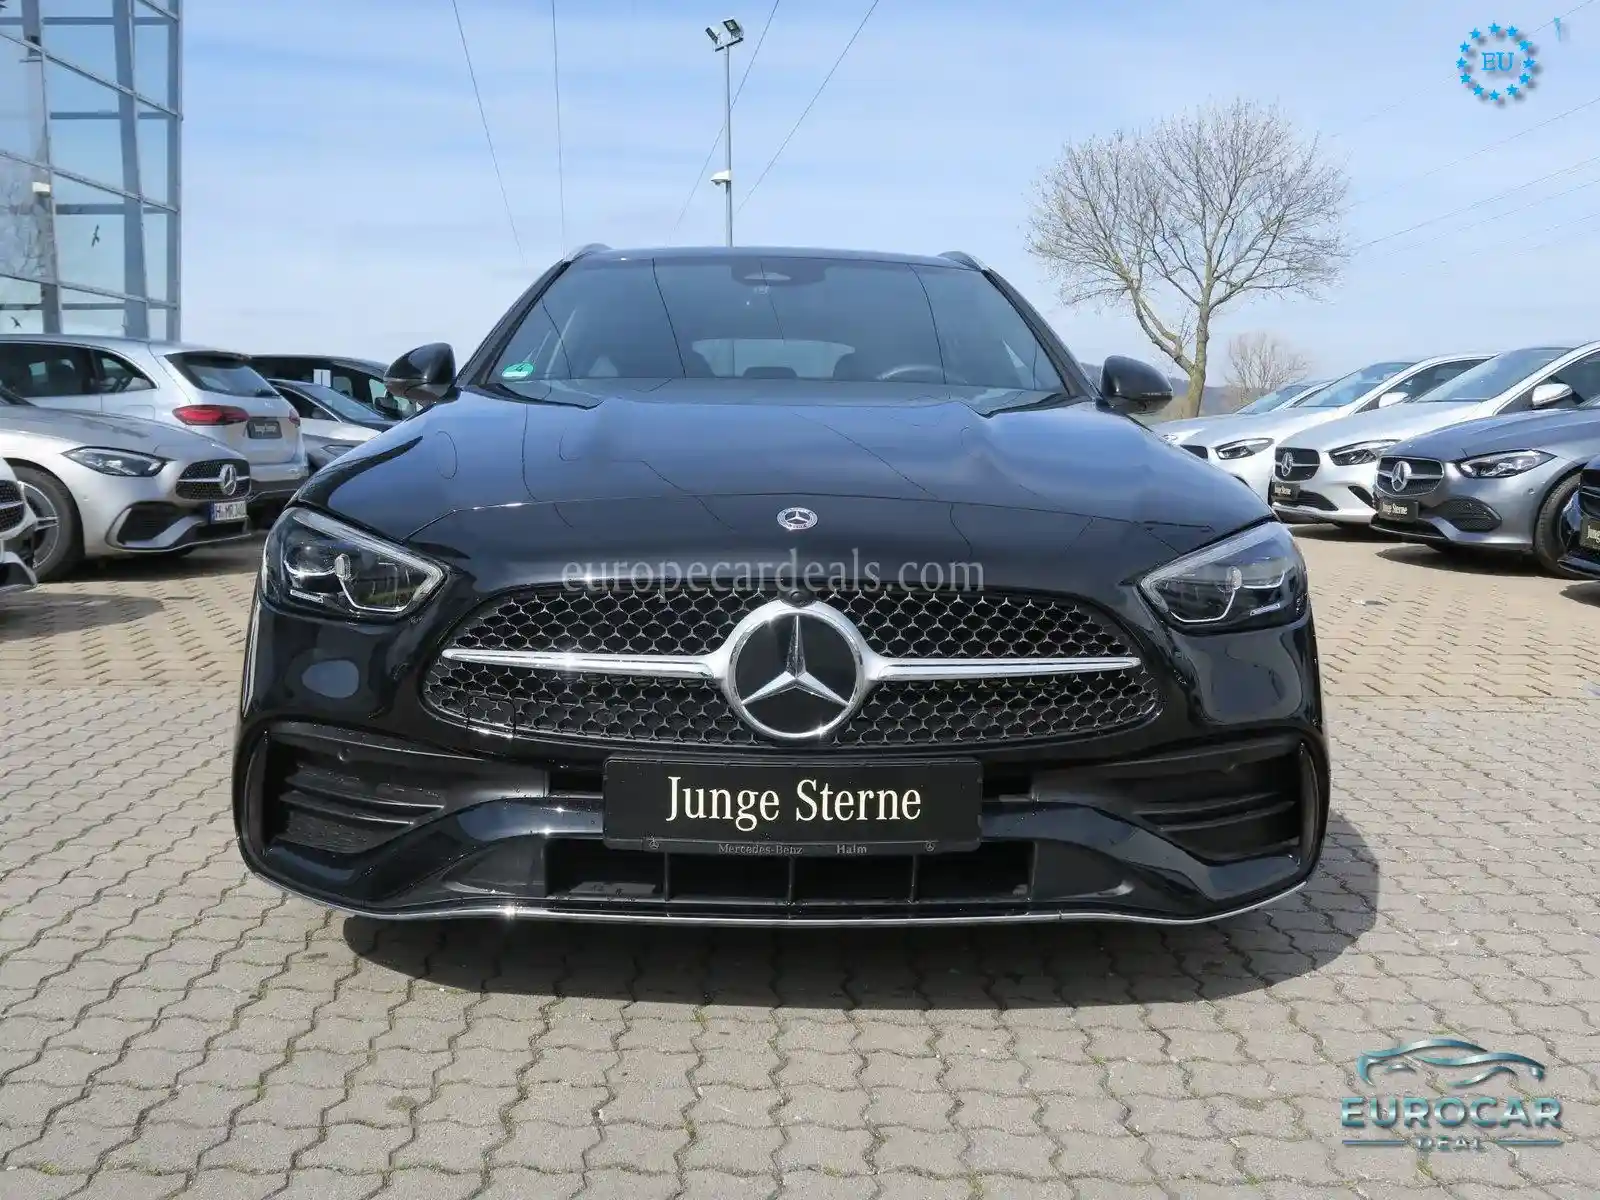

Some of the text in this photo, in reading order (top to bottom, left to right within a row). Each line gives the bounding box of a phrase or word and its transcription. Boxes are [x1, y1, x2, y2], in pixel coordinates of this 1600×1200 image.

[665, 776, 921, 831] Junge Sterne
[718, 843, 803, 855] Mercedes-Benz
